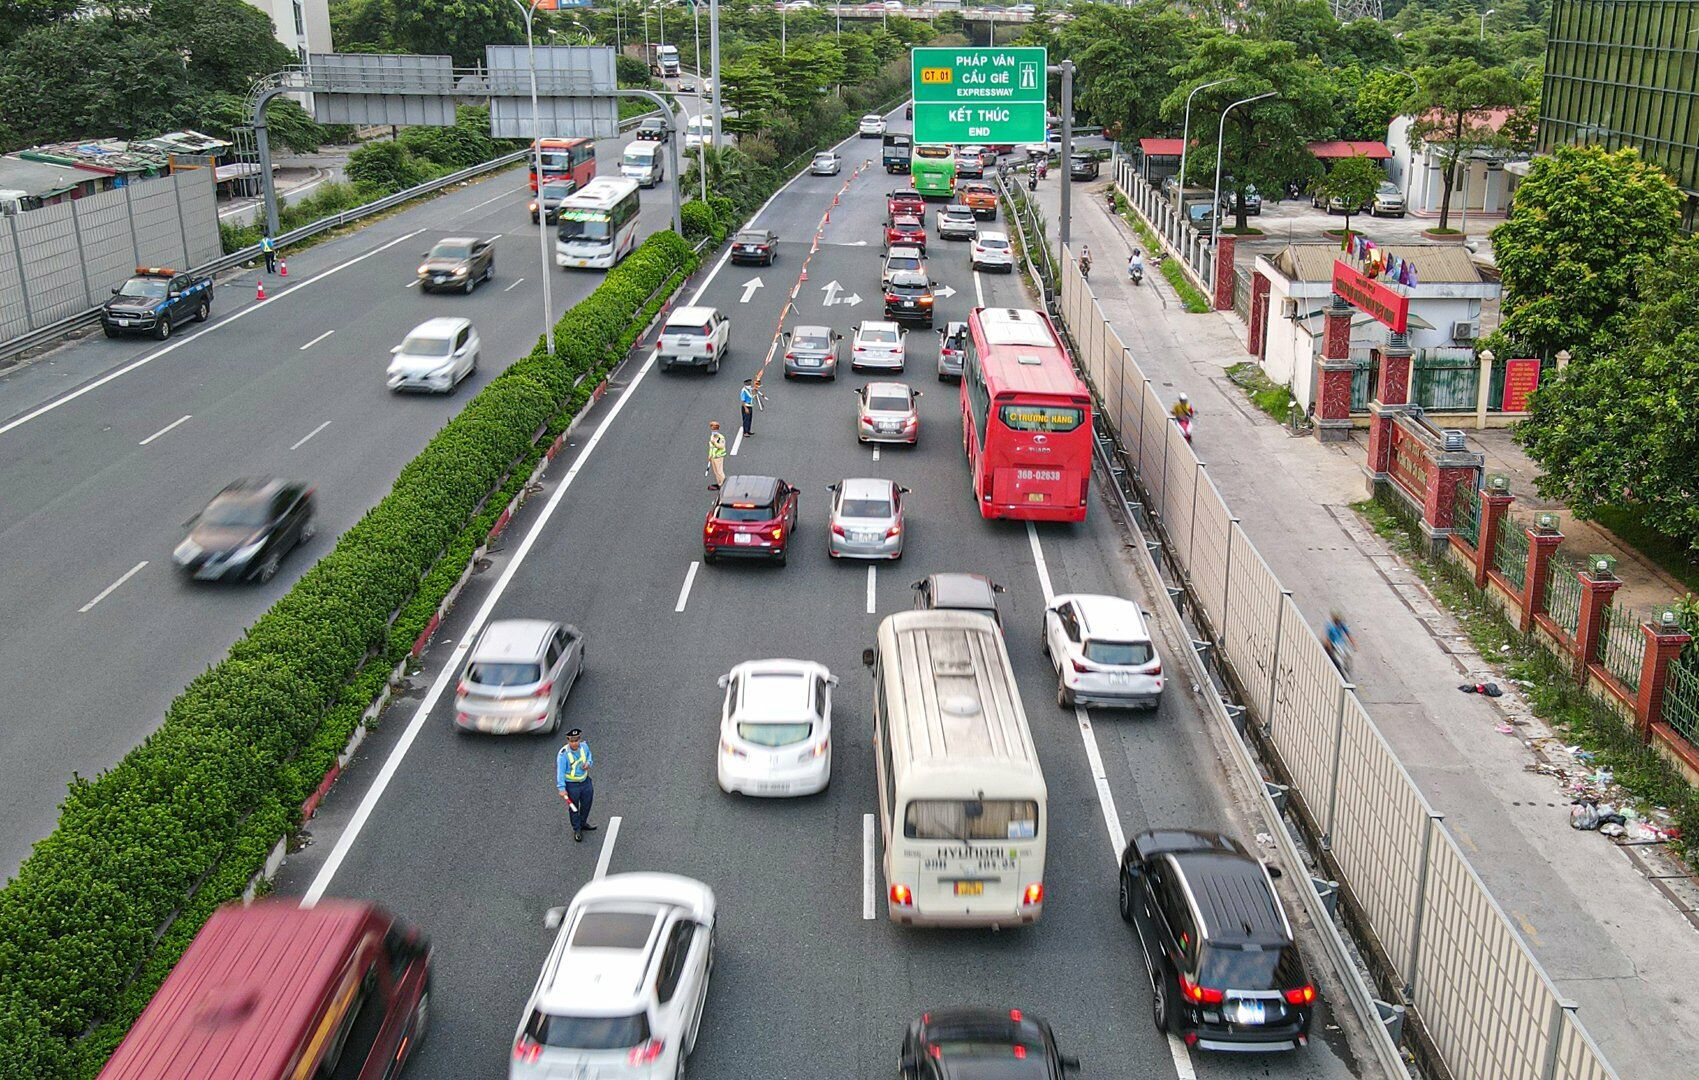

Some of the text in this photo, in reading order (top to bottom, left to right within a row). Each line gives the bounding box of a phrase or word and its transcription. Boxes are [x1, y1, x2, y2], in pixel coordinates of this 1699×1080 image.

[956, 53, 1015, 66] PHÁP VÂN
[962, 69, 986, 83] CẦU
[956, 88, 1013, 96] EXPRESSWAY
[948, 105, 1010, 121] KẾT THÚC
[969, 127, 990, 136] END
